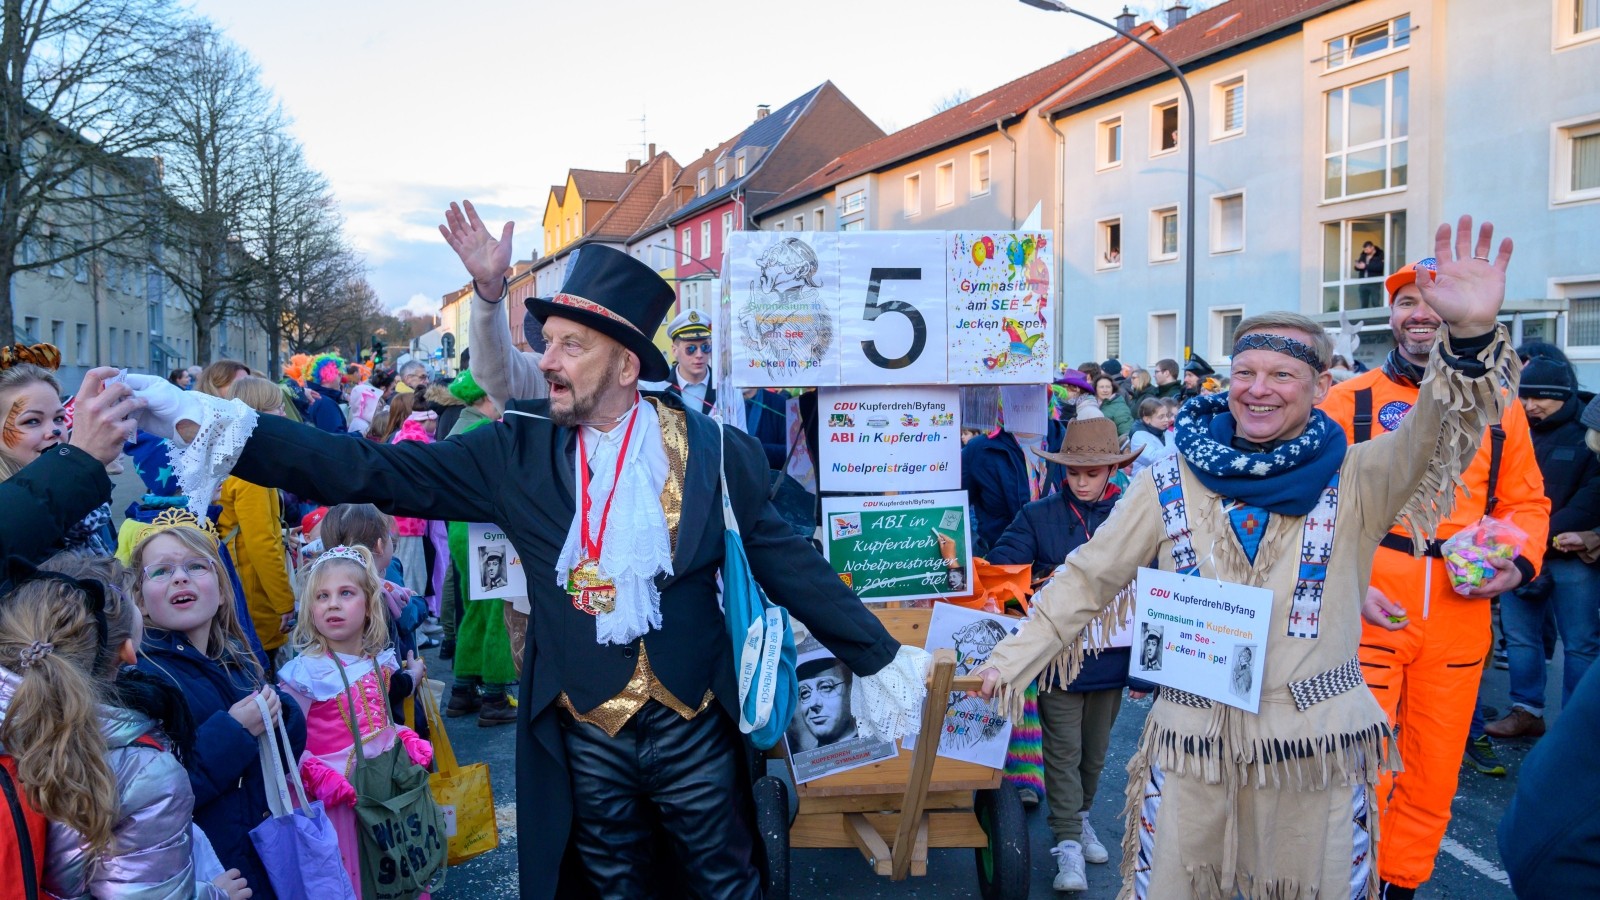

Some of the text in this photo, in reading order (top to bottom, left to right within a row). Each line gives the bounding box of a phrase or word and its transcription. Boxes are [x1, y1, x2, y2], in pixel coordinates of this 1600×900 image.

[960, 280, 1039, 294] Gymnasium
[748, 302, 808, 312] Gymnasium
[968, 302, 987, 310] am
[992, 299, 1020, 310] SEE
[860, 268, 926, 369] 5
[956, 318, 998, 328] Jecken
[1018, 320, 1044, 330] spe!
[784, 329, 804, 338] See
[748, 358, 822, 368] Jecken in spe!
[834, 402, 946, 412] CDU Kupferdreh/Byfang
[830, 432, 854, 442] ABI
[858, 432, 870, 442] in
[874, 432, 940, 445] Kupferdreh
[832, 462, 926, 474] Nobelpreisträger
[879, 498, 935, 508] Kupferdreh/Byfang
[872, 514, 928, 530] ABI in
[484, 532, 507, 542] Gym
[853, 535, 938, 555] Kupferdreh
[510, 556, 521, 565] Je
[844, 557, 958, 574] Nobelpreisträger
[1150, 587, 1256, 618] CDU Kupferdreh/Byfang
[1148, 608, 1194, 626] Gymnasium
[1196, 619, 1204, 628] in
[1206, 621, 1252, 640] Kupferdreh
[1180, 631, 1192, 640] am
[1194, 633, 1210, 644] See
[768, 644, 776, 659] BIN
[1165, 642, 1227, 664] Jecken in spe!
[766, 658, 774, 672] ICH
[761, 671, 772, 704] MENSCH
[946, 704, 1007, 727] preisträger
[811, 750, 850, 766] KUPFERDREH
[835, 751, 870, 765] GYMNASIUM
